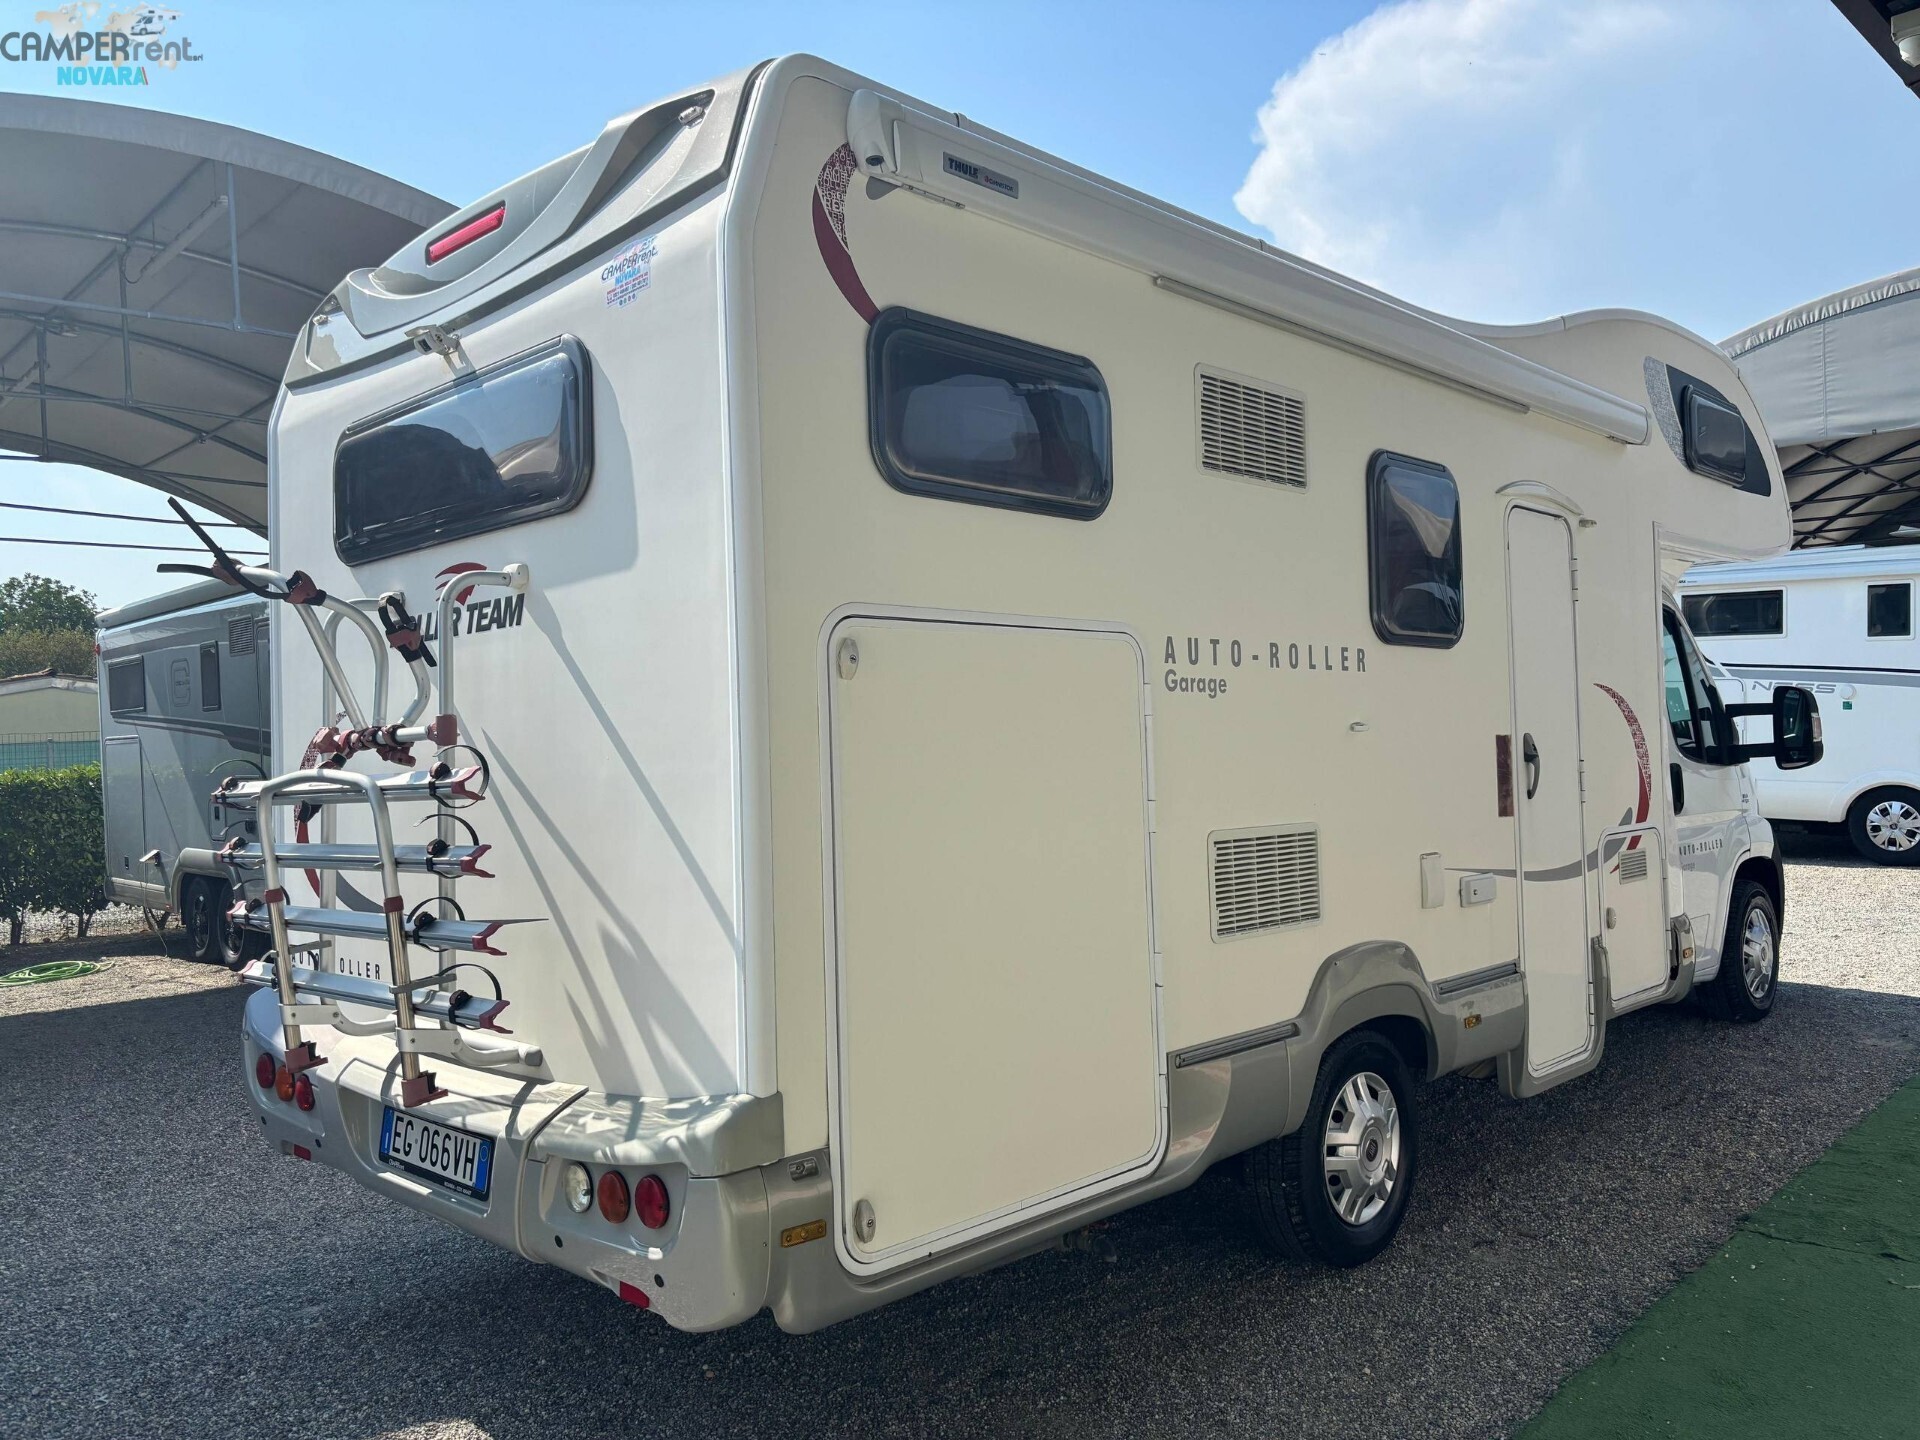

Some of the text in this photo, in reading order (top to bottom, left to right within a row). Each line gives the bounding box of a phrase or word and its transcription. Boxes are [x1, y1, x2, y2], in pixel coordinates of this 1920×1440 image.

[948, 157, 979, 179] THULE
[466, 593, 525, 635] TEAM
[1164, 635, 1366, 672] AUTO-ROLLER
[1164, 668, 1227, 699] Garage
[1752, 681, 1836, 694] NSS
